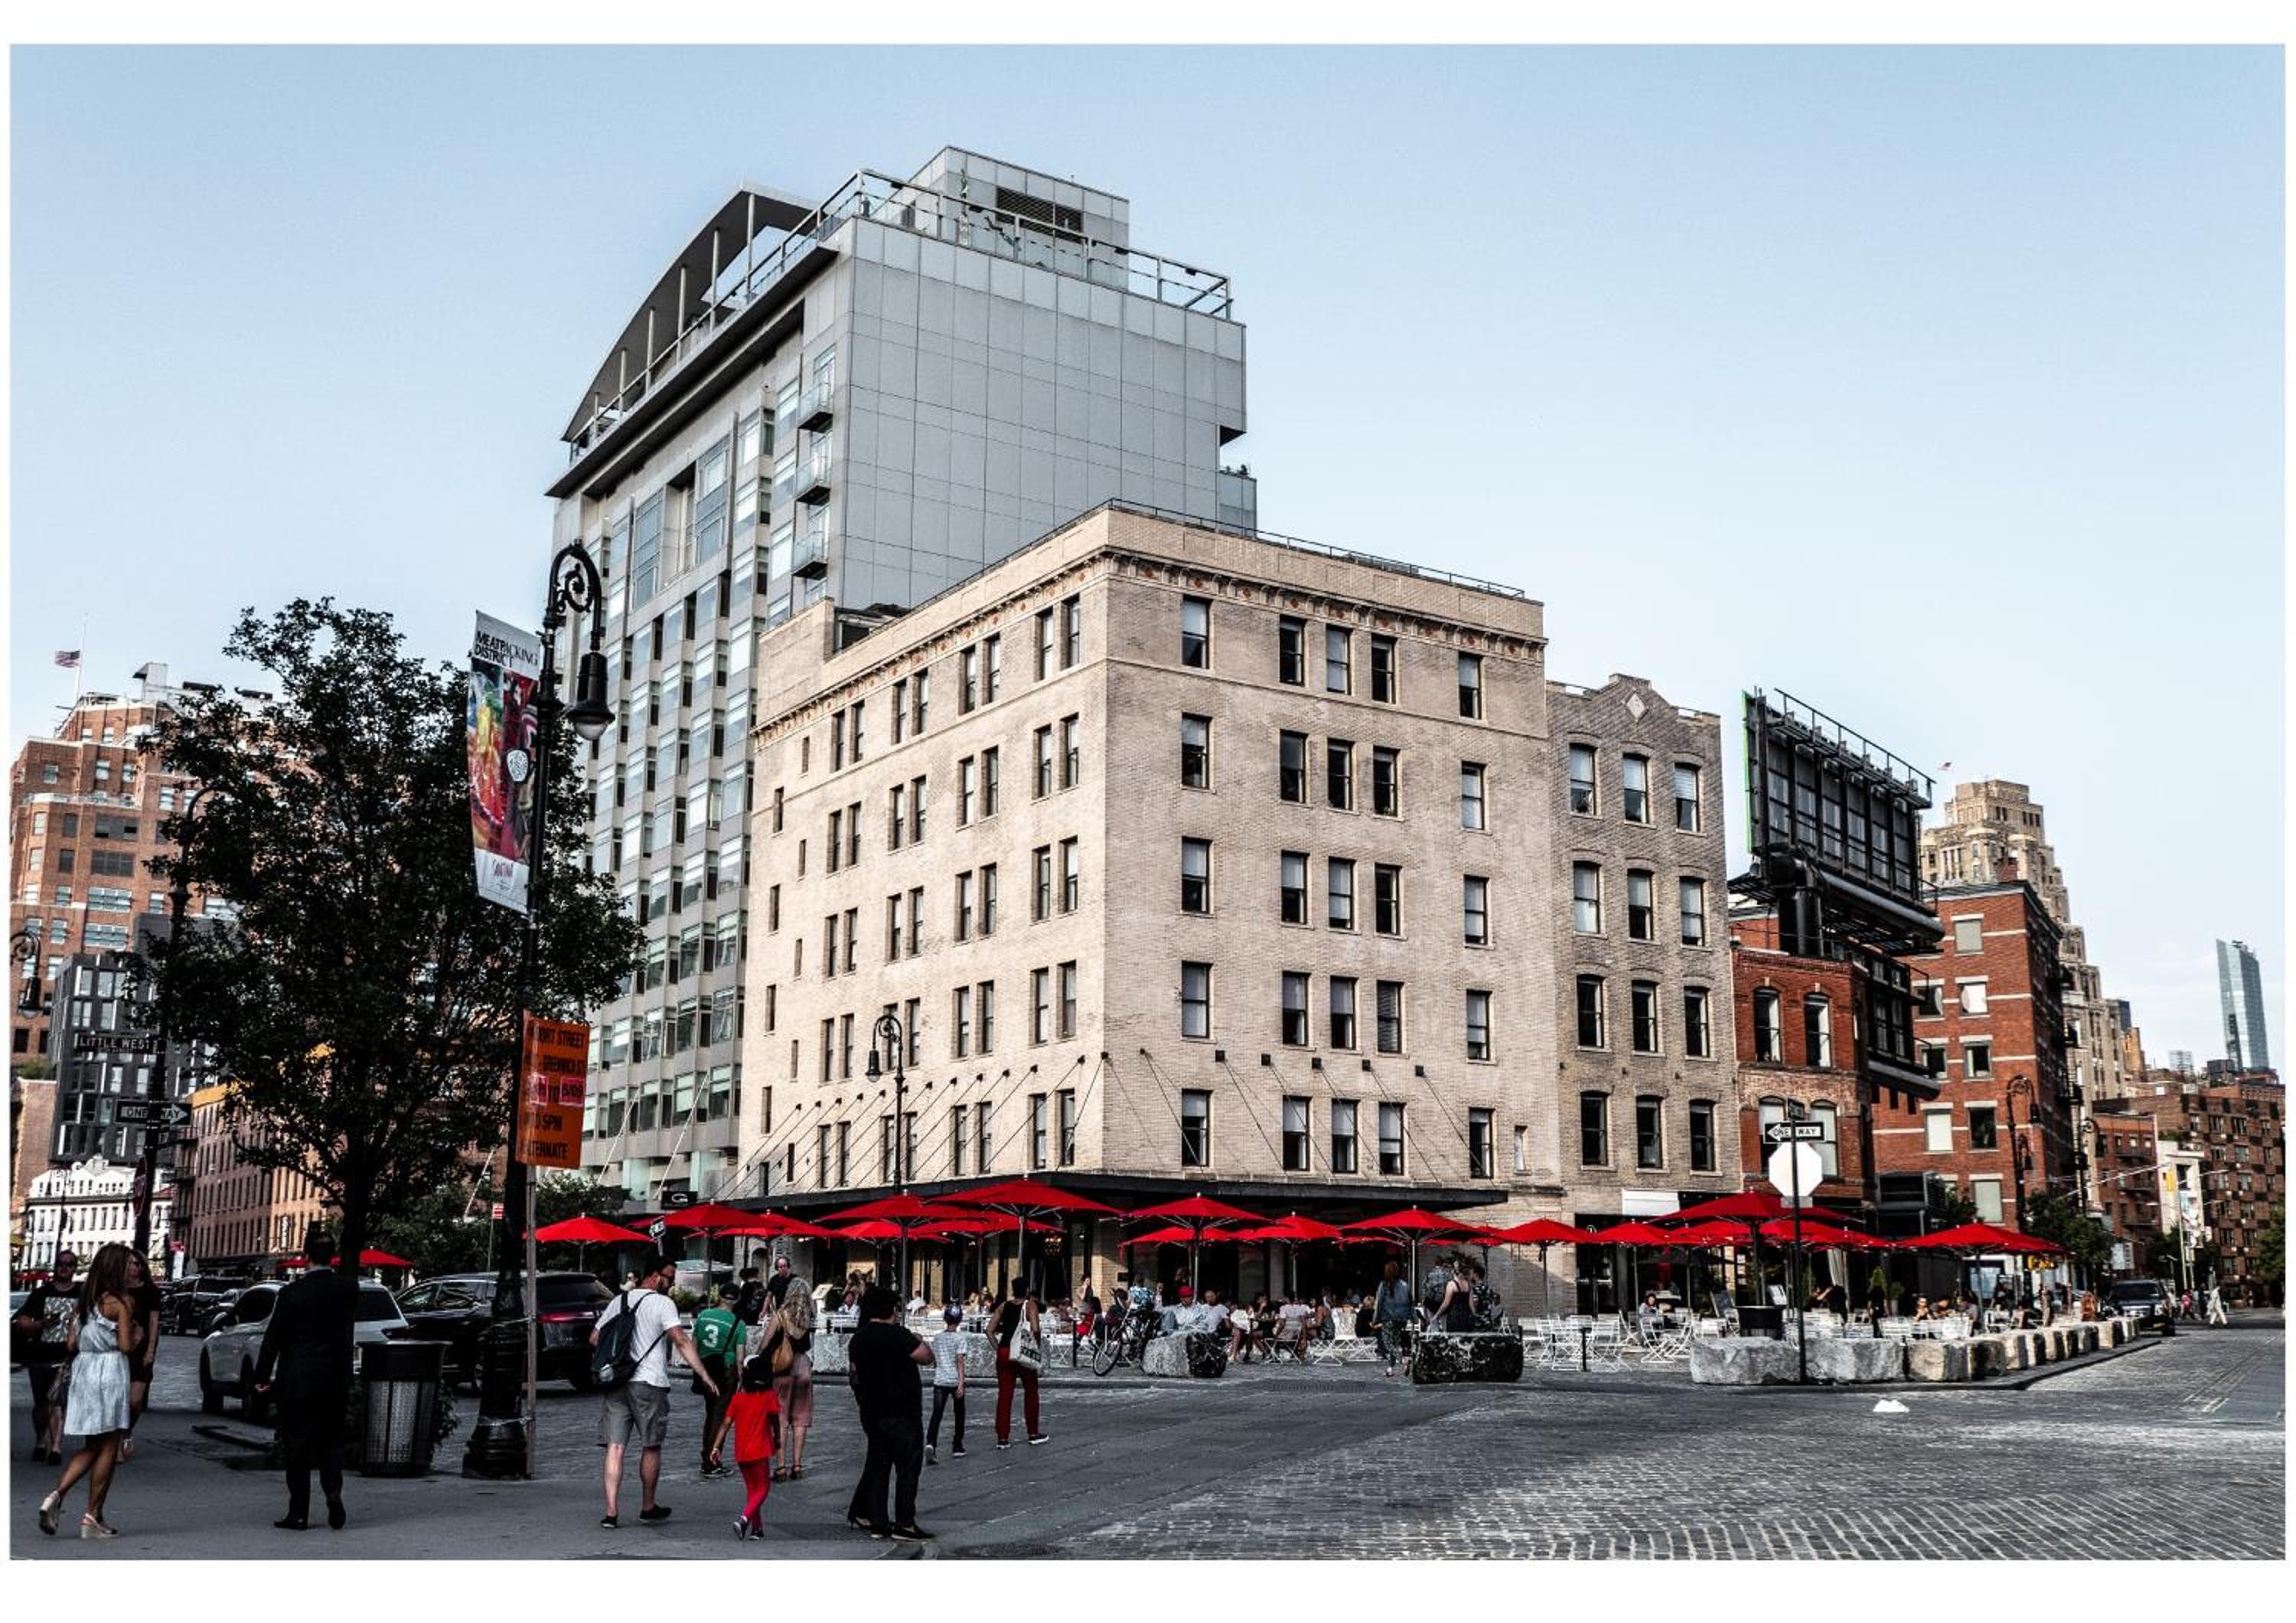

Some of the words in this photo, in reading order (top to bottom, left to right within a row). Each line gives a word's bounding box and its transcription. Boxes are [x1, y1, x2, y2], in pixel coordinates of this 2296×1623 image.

[475, 630, 539, 665] MEATPACKING
[475, 643, 512, 668] DISTRICT
[79, 1037, 117, 1048] LITTLE
[122, 1037, 150, 1050] WEST
[558, 1029, 585, 1049] STREET
[548, 1086, 560, 1103] TO
[126, 1107, 148, 1119] ONE
[1773, 1128, 1789, 1138] ONE
[703, 1324, 719, 1348] 3
